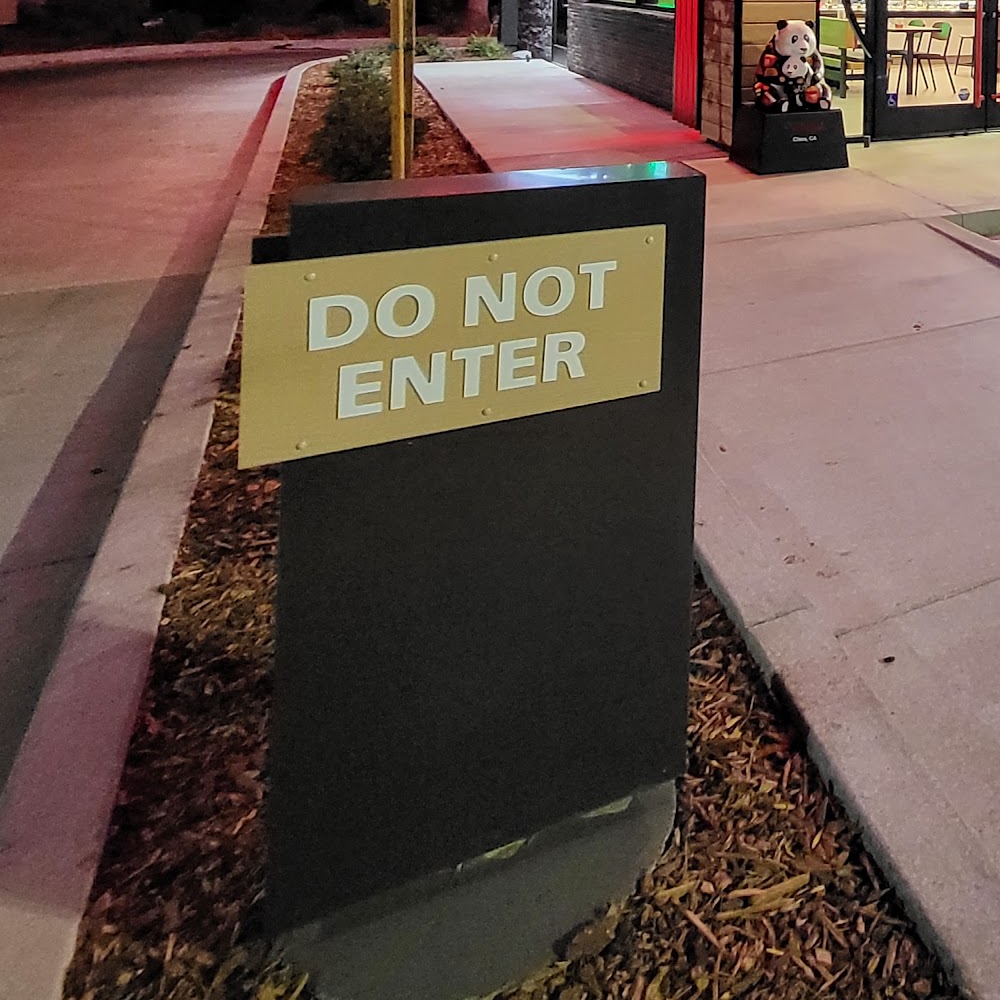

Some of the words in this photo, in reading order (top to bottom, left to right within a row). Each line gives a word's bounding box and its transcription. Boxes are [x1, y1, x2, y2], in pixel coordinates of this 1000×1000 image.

[308, 284, 436, 352] DO
[463, 260, 618, 328] NOT
[336, 331, 587, 420] ENTER
